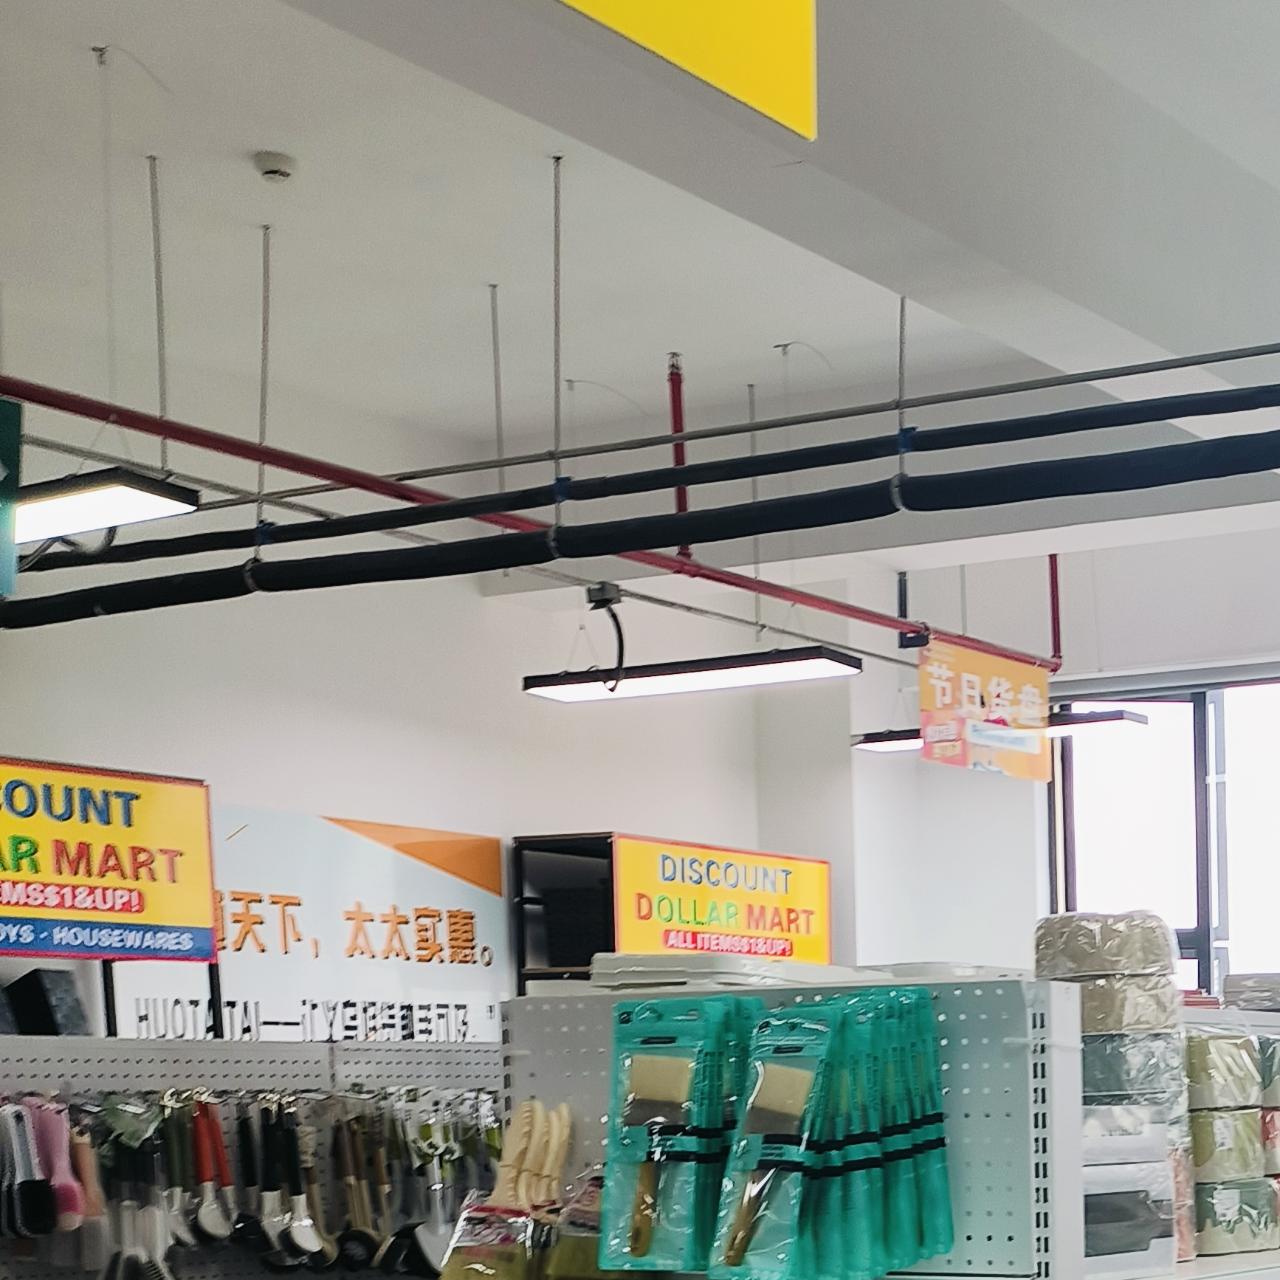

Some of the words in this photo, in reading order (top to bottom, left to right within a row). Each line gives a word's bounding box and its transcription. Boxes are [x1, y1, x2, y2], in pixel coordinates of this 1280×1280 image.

[0, 779, 139, 828] OUNT
[53, 839, 183, 883] MART
[660, 854, 793, 895] DISCOUNT
[216, 889, 494, 967] 天下，太太实惠。
[635, 892, 740, 929] DOLLAR
[746, 903, 815, 934] MART
[52, 925, 194, 950] HOUSEWARES
[667, 930, 696, 949] ALL
